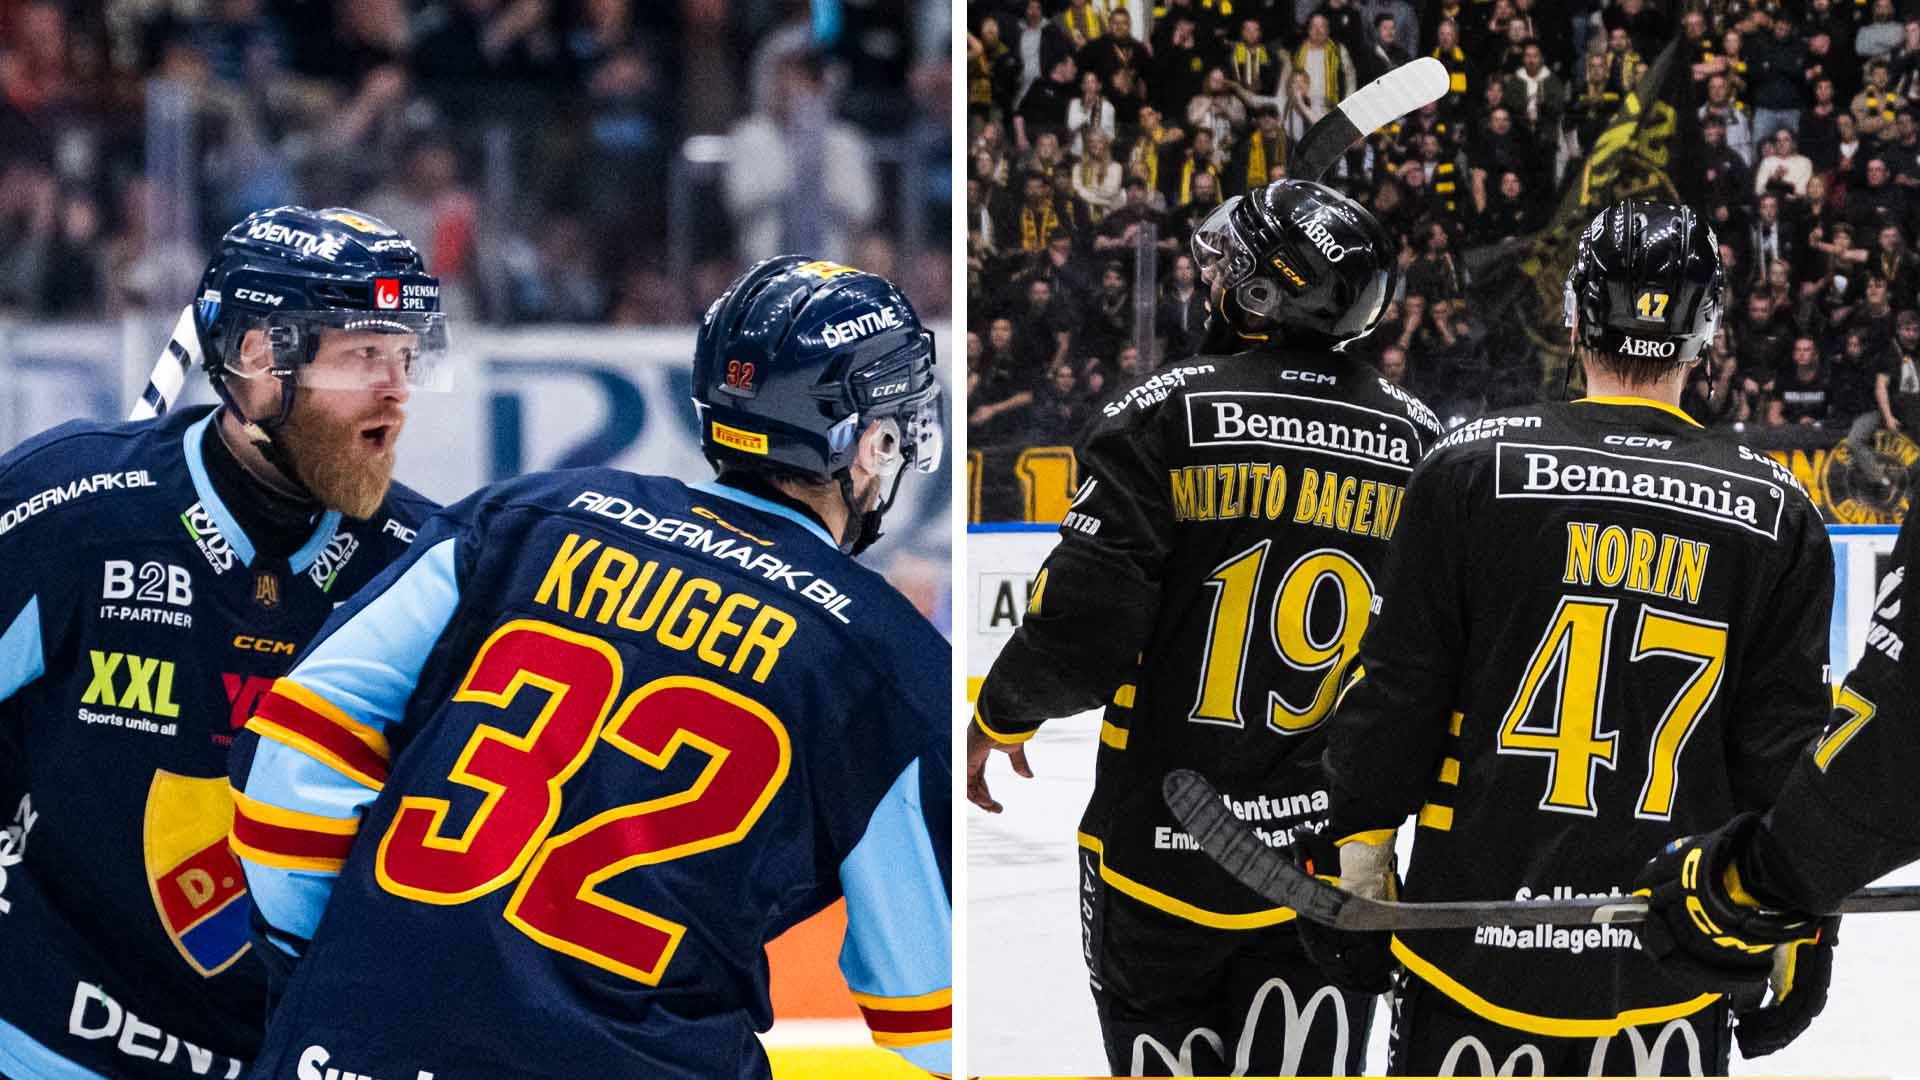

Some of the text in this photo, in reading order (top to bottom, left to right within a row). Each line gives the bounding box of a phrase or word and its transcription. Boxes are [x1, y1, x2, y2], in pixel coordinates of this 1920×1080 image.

[250, 221, 345, 262] DENTME
[1270, 257, 1307, 286] CCM
[234, 288, 284, 306] CCM
[403, 298, 425, 309] SPEL
[1636, 292, 1670, 319] 47
[821, 305, 901, 349] DENTME
[1618, 335, 1676, 359] ÅBRO
[726, 359, 756, 390] 32
[871, 382, 907, 398] CCM
[1103, 364, 1216, 418] Sundsten
[1280, 369, 1338, 386] CCM
[715, 426, 762, 449] PIRELLI
[1211, 401, 1411, 465] Bemannia
[1603, 434, 1673, 451] CCM
[0, 470, 157, 536] IDDERMARK BIL
[1168, 462, 1287, 522] MUZITO
[1523, 452, 1758, 525] Bemannia
[568, 490, 853, 625] RIDDERMARK BIL
[1562, 521, 1710, 605] NORIN
[102, 560, 194, 607] B2B
[99, 605, 193, 629] IT-PARTNER
[533, 532, 798, 685] KRUGER
[232, 634, 295, 656] CCM
[1187, 538, 1375, 736] 19
[80, 649, 181, 719] XXL
[78, 707, 177, 736] Sports unite all
[1496, 594, 1730, 822] 47
[374, 618, 793, 988] 32
